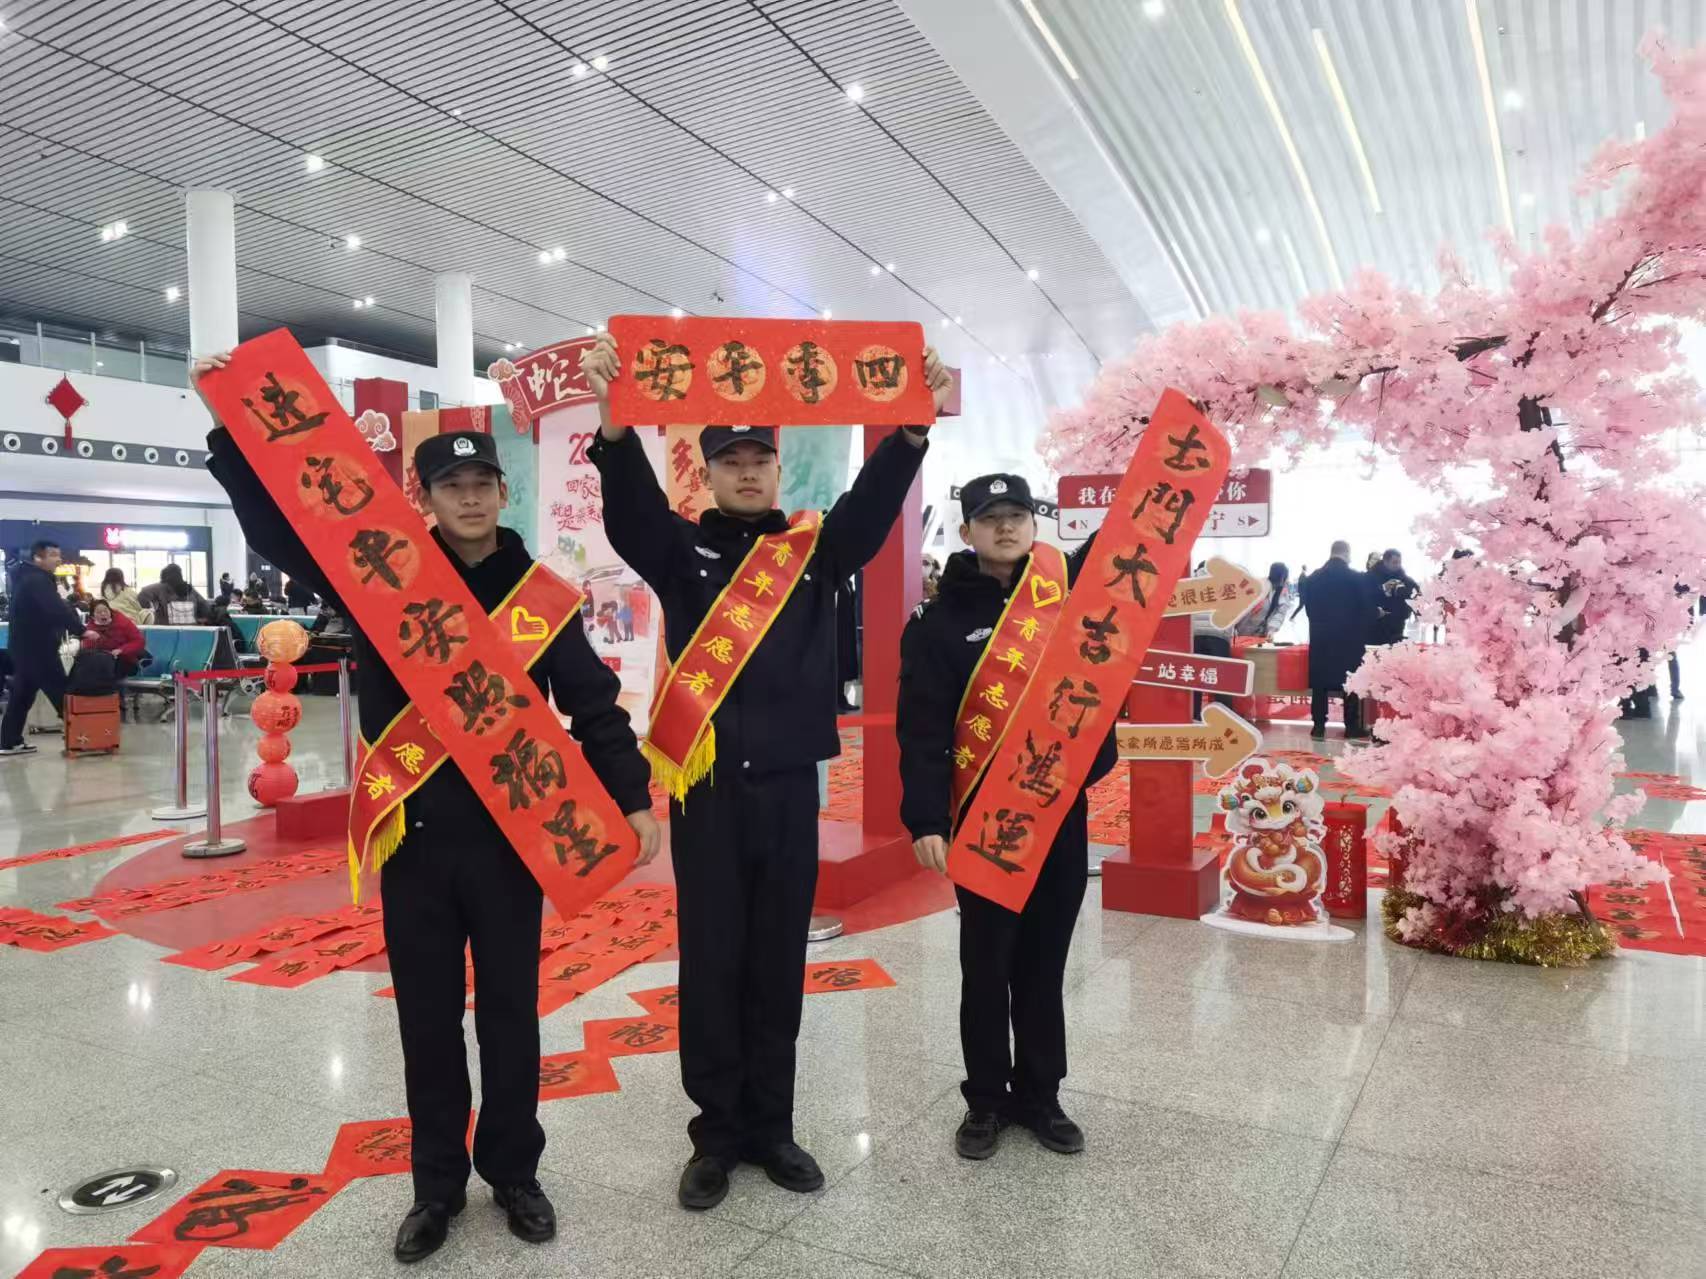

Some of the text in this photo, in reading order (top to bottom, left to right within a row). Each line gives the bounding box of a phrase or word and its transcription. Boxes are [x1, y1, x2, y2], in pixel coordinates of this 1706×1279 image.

[1079, 520, 1089, 530] N
[1237, 516, 1246, 527] S
[671, 541, 793, 696] 青年志愿者
[1141, 663, 1219, 685] 一站幸福
[953, 615, 1041, 769] 青年志愿者
